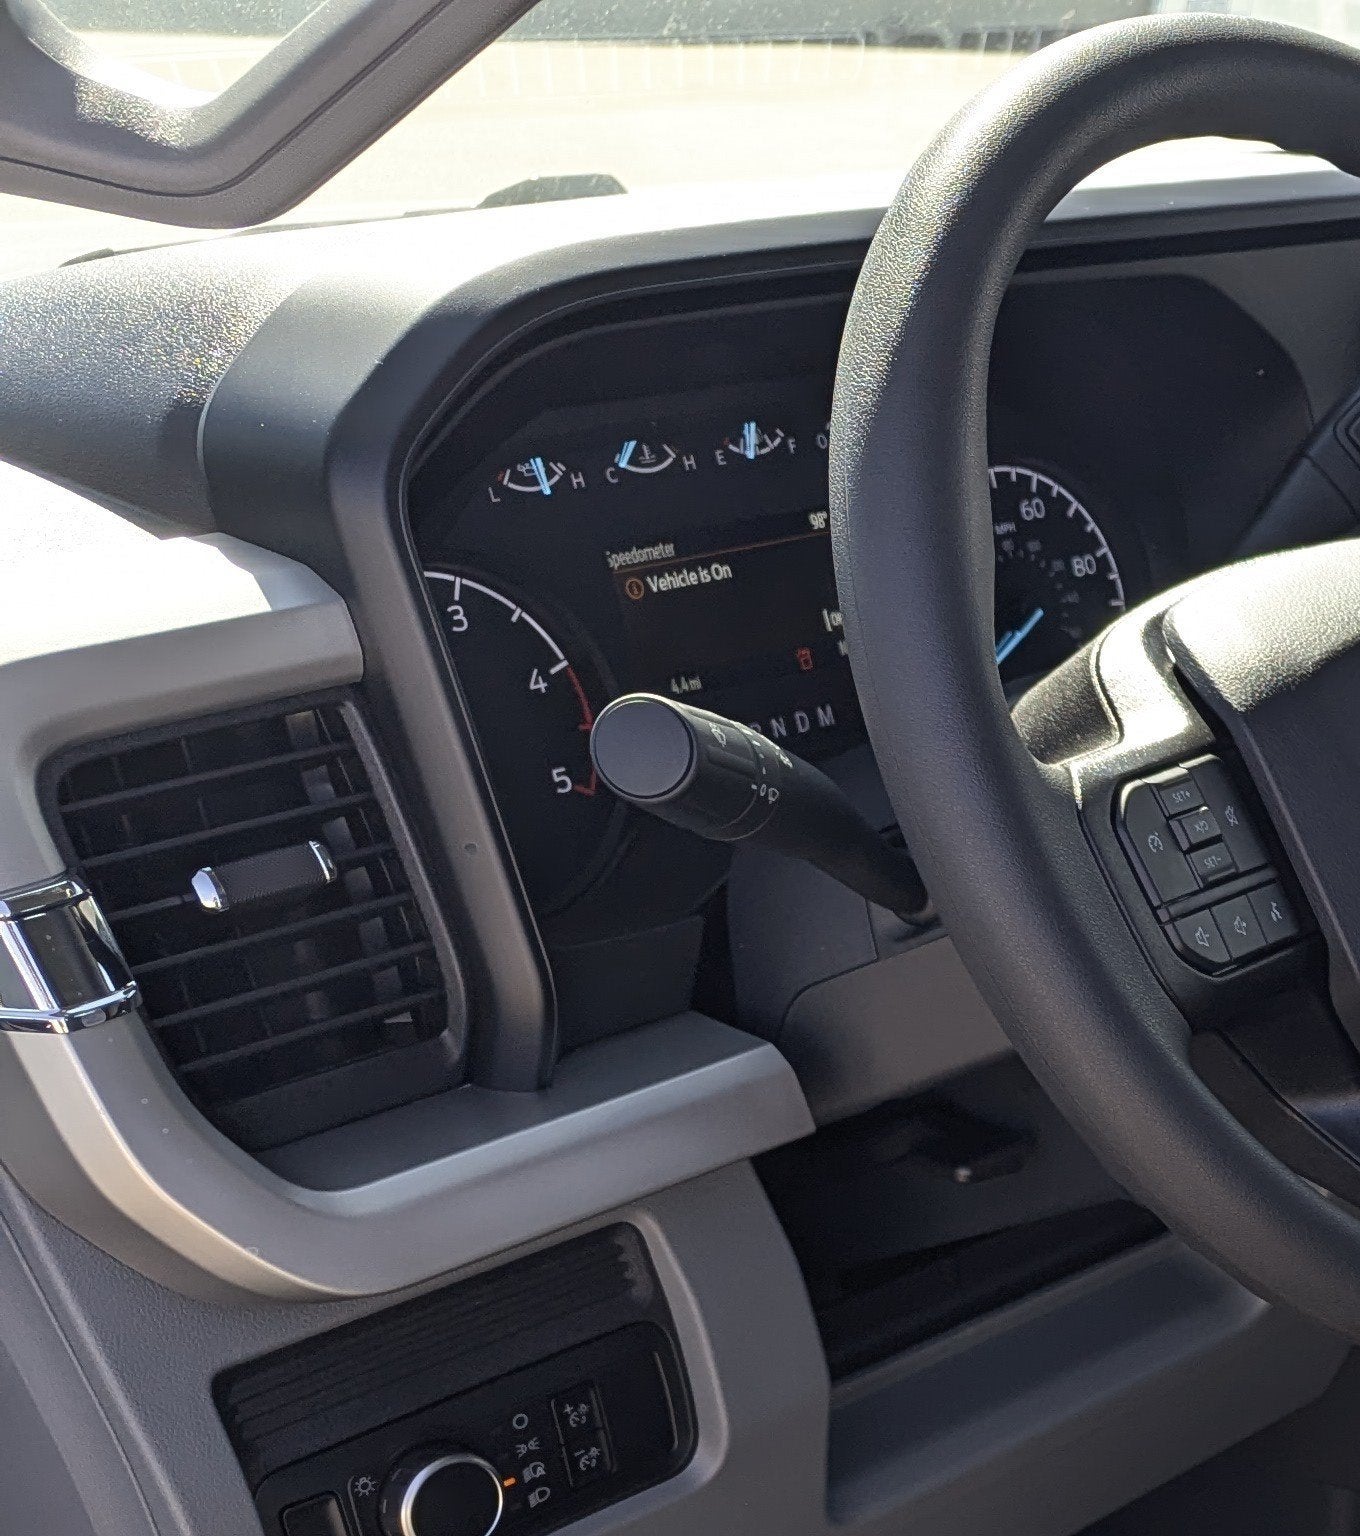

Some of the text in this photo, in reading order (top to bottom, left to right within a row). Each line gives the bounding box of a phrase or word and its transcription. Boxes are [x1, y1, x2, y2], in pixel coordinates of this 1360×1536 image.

[787, 438, 797, 454] F
[683, 455, 697, 471] H
[715, 451, 727, 467] E
[570, 472, 586, 489] H
[605, 467, 619, 484] C
[488, 487, 501, 503] L
[1019, 497, 1046, 521] 60
[1071, 553, 1097, 578] 80
[646, 563, 732, 593] Vehicle is On
[446, 604, 469, 632] 3
[529, 668, 548, 694] 4
[769, 717, 787, 739] N
[793, 710, 811, 734] D
[817, 703, 836, 728] M
[552, 766, 573, 794] 5
